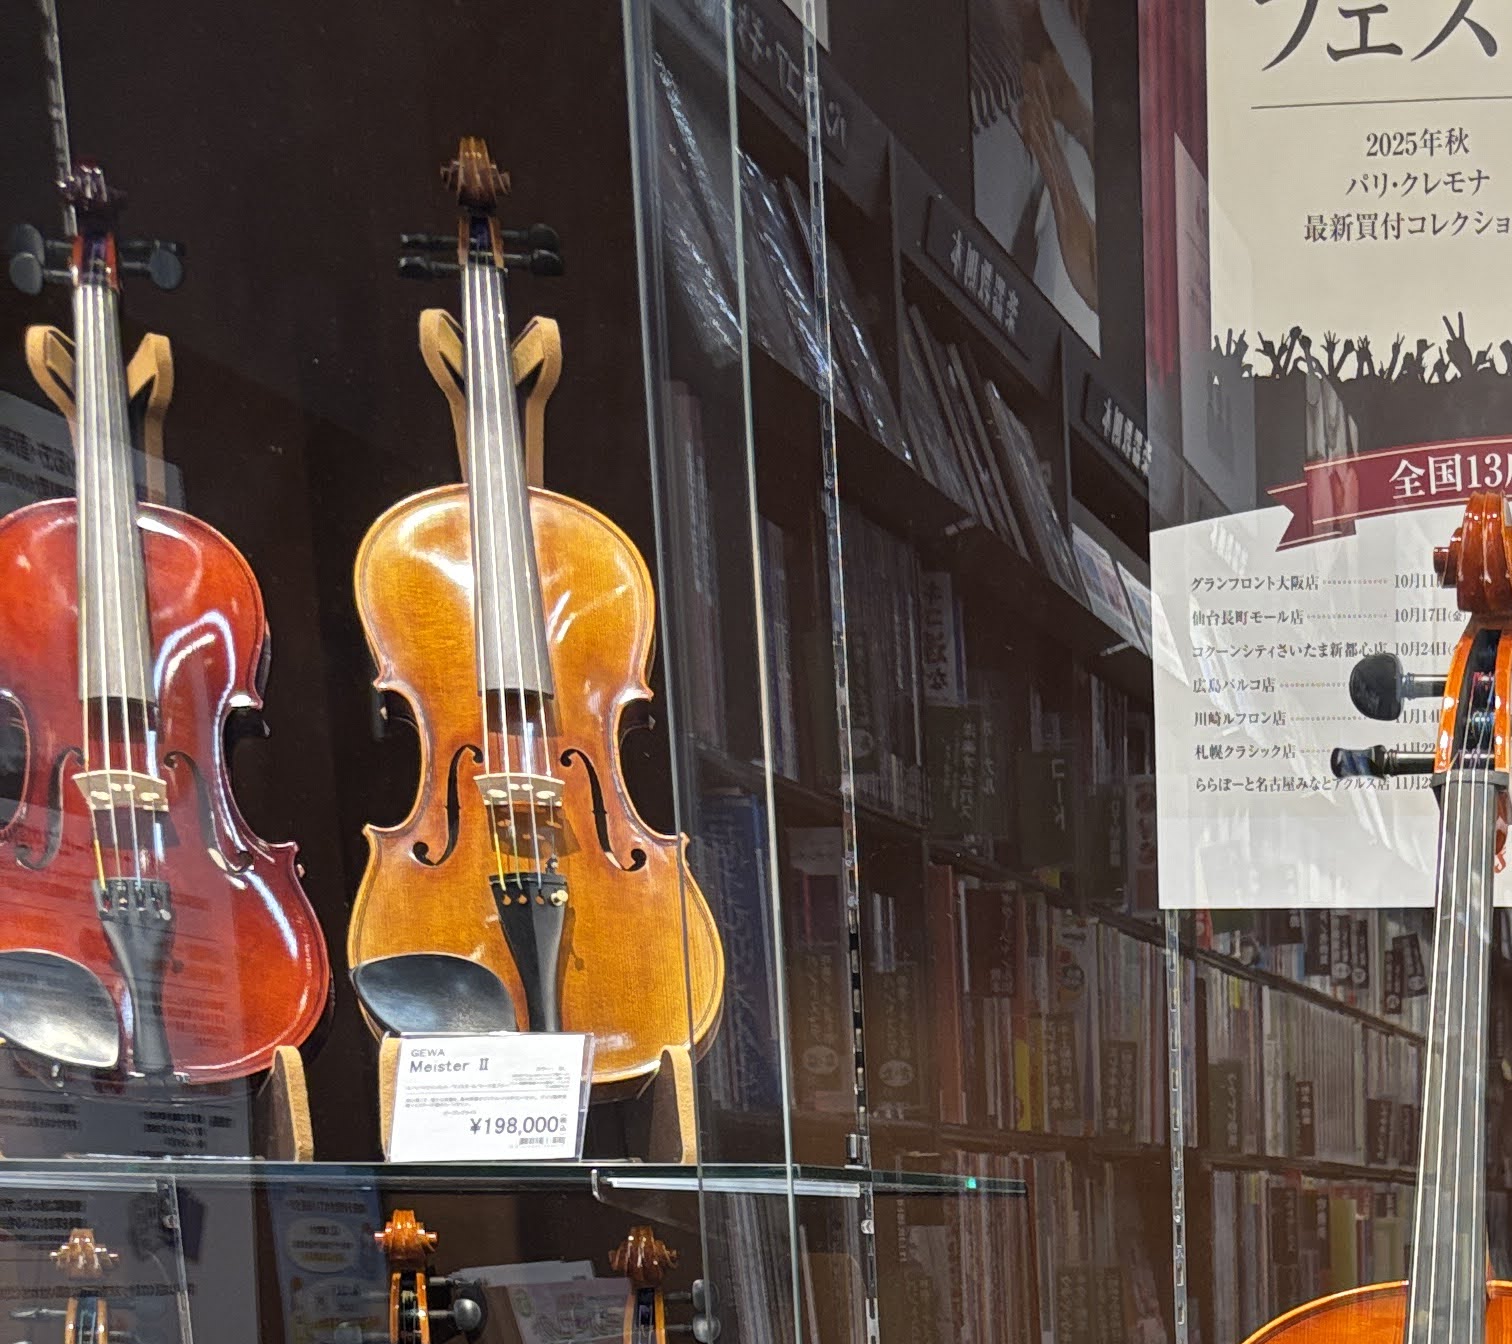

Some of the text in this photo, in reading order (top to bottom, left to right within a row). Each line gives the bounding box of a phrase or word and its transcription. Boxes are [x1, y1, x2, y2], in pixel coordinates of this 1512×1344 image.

[1364, 129, 1471, 158] 2025年秋
[1345, 169, 1491, 198] パリ・クレモナ
[1191, 573, 1443, 592] グランフロント大阪店 10月11
[1192, 607, 1467, 626] 仙台長町モール店 10月17日(金)
[1192, 642, 1458, 659] コクーンシティさいたま新都心店 10月24日(
[1192, 678, 1275, 694] 広島パルコ店
[1194, 711, 1286, 727] 川崎ルフロン店
[1195, 744, 1296, 760] 札幌クラシック店
[1196, 777, 1389, 793] ららぽーと名古屋みなとアクルス店
[410, 1048, 445, 1057] GEWA
[409, 1060, 470, 1073] Meister
[469, 1116, 559, 1136] ¥198,000
